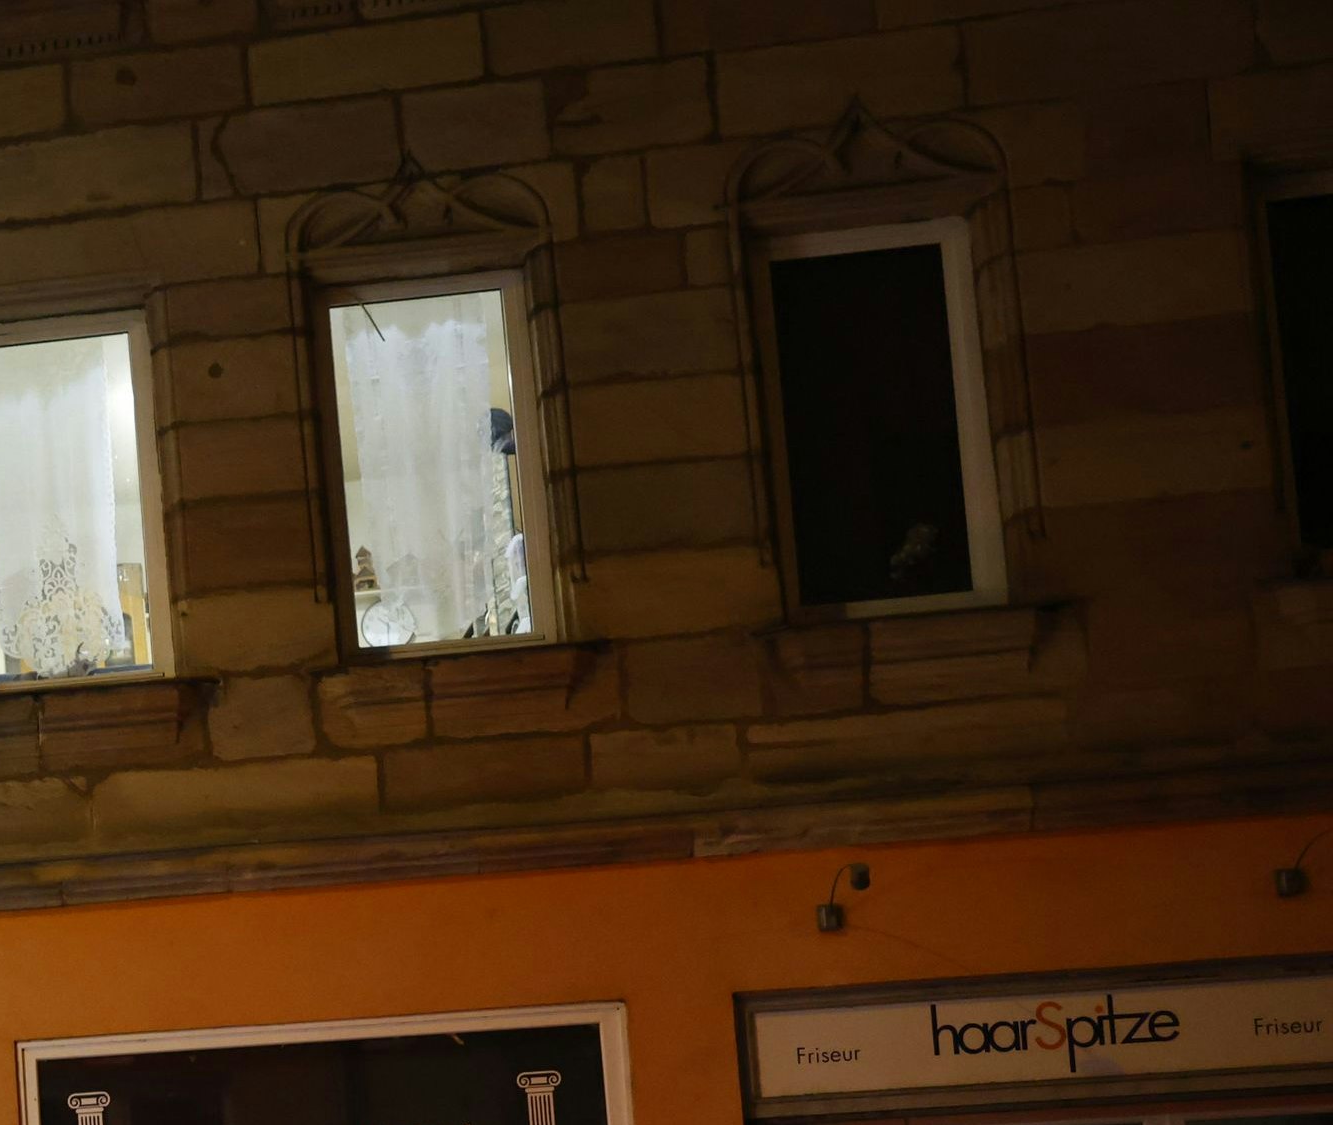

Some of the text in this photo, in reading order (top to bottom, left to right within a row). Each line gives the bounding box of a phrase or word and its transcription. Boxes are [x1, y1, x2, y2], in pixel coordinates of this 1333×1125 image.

[931, 994, 1180, 1073] haarSpitze
[1253, 1017, 1322, 1036] Friseur
[796, 1047, 861, 1065] Friseur
